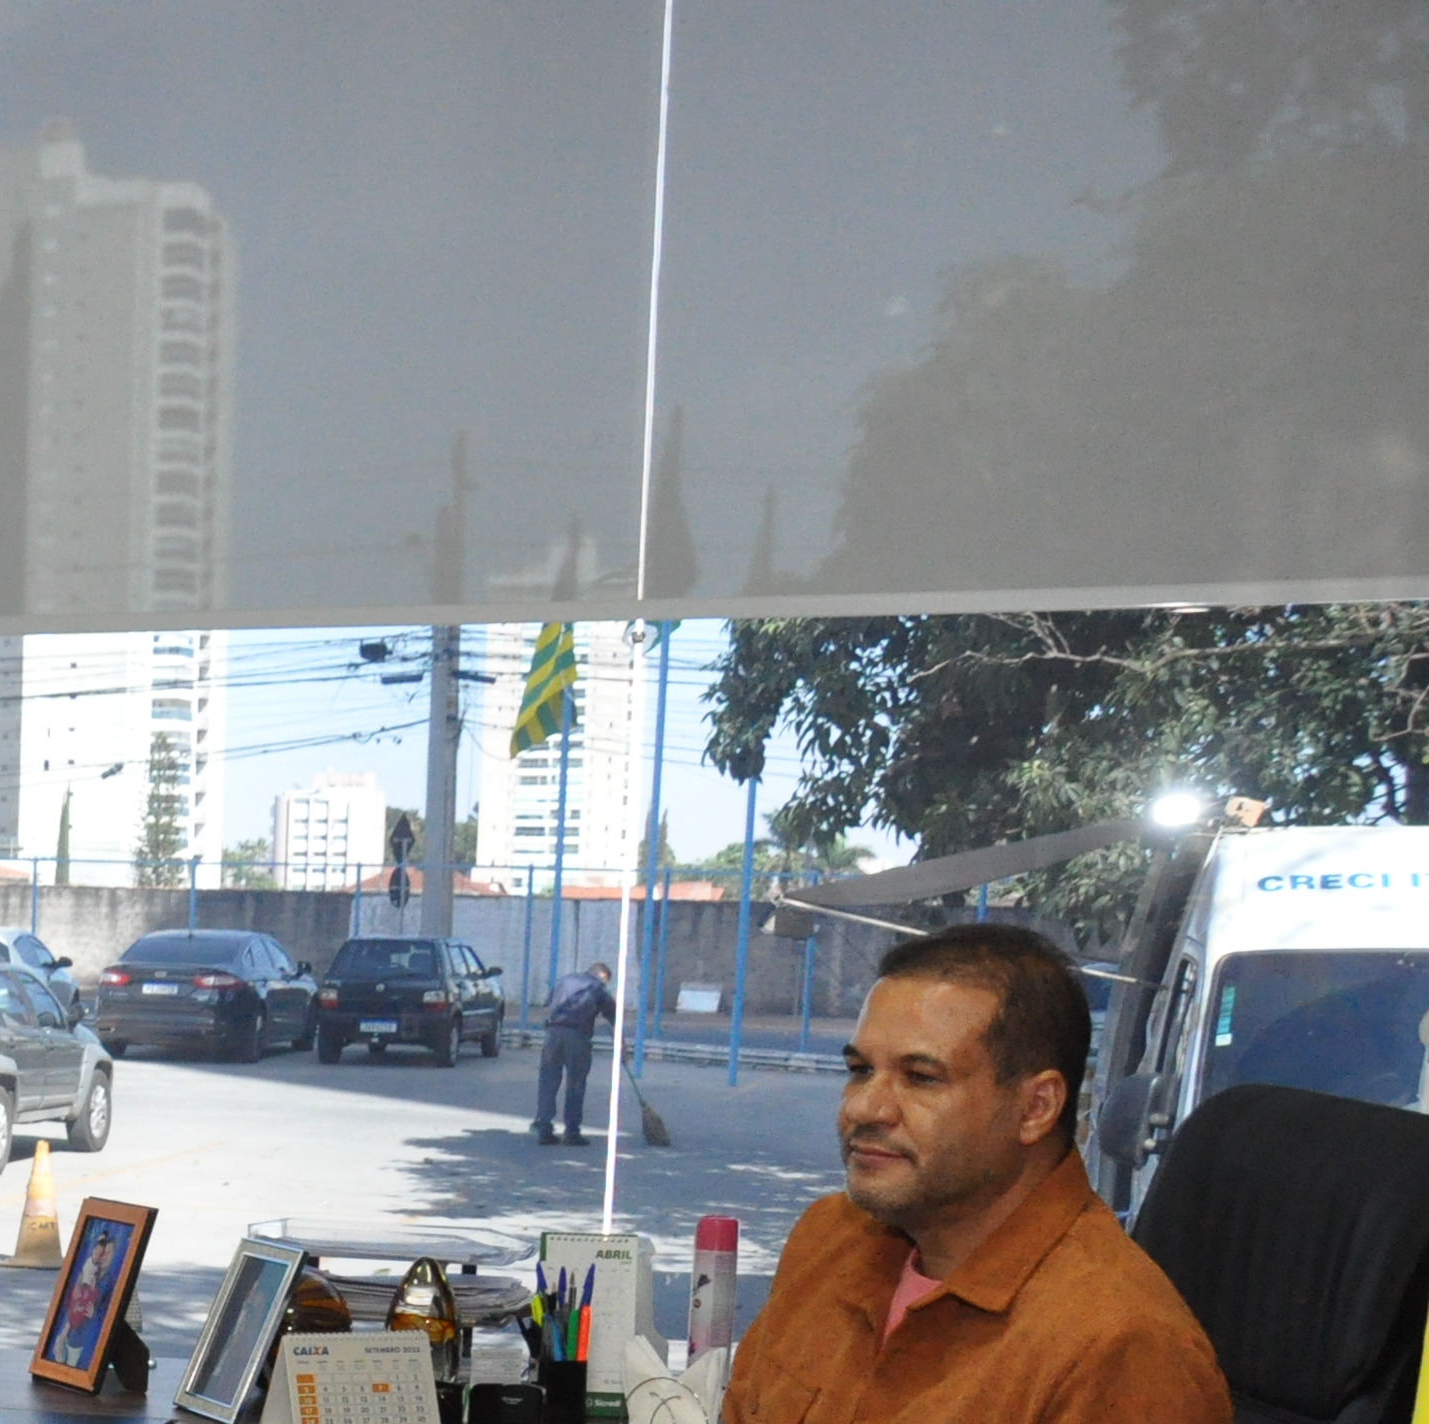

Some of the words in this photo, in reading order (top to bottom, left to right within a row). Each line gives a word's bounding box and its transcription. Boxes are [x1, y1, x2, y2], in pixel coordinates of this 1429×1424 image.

[1257, 873, 1390, 892] CRECI
[596, 1249, 632, 1260] ABRIL
[293, 1346, 329, 1356] CAIXA
